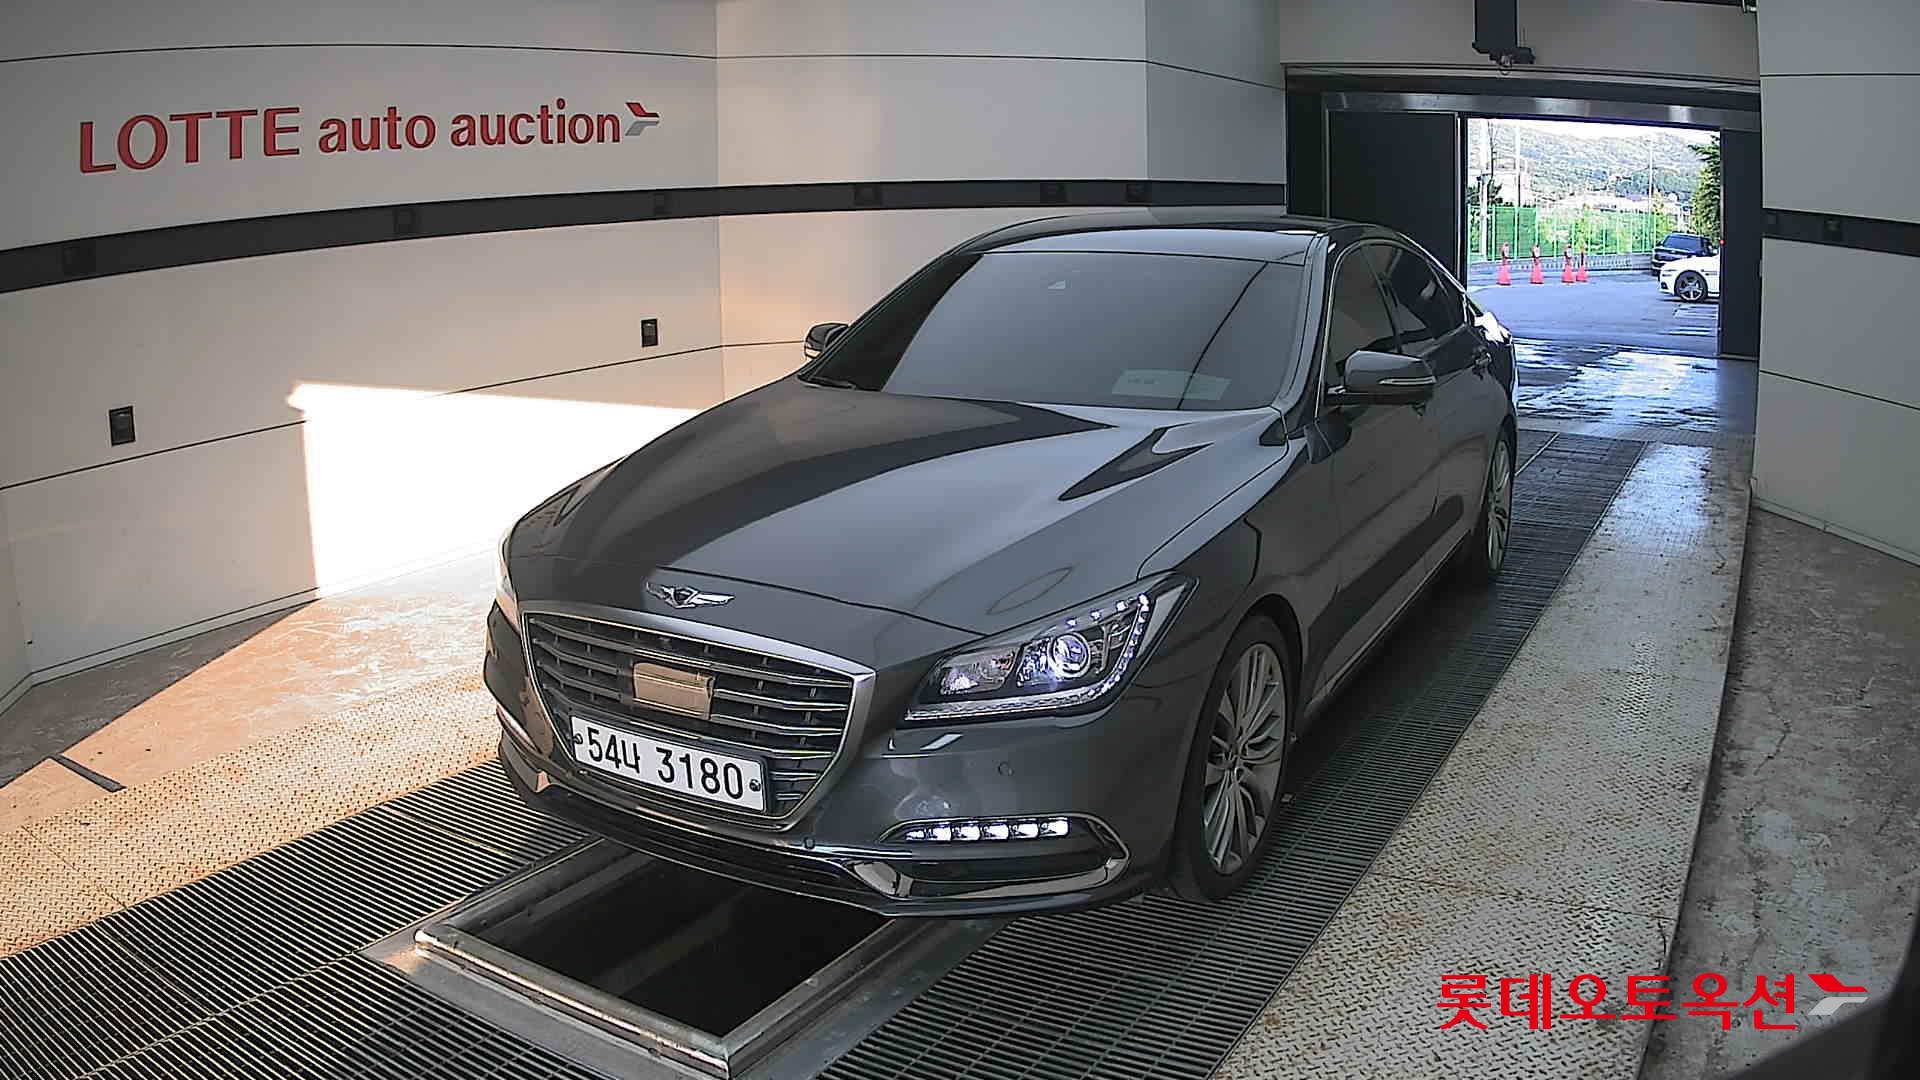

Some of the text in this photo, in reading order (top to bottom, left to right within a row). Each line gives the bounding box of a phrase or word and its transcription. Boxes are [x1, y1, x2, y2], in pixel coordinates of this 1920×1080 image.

[79, 98, 621, 173] LOTTE auto auction
[587, 726, 744, 800] 54나 3180
